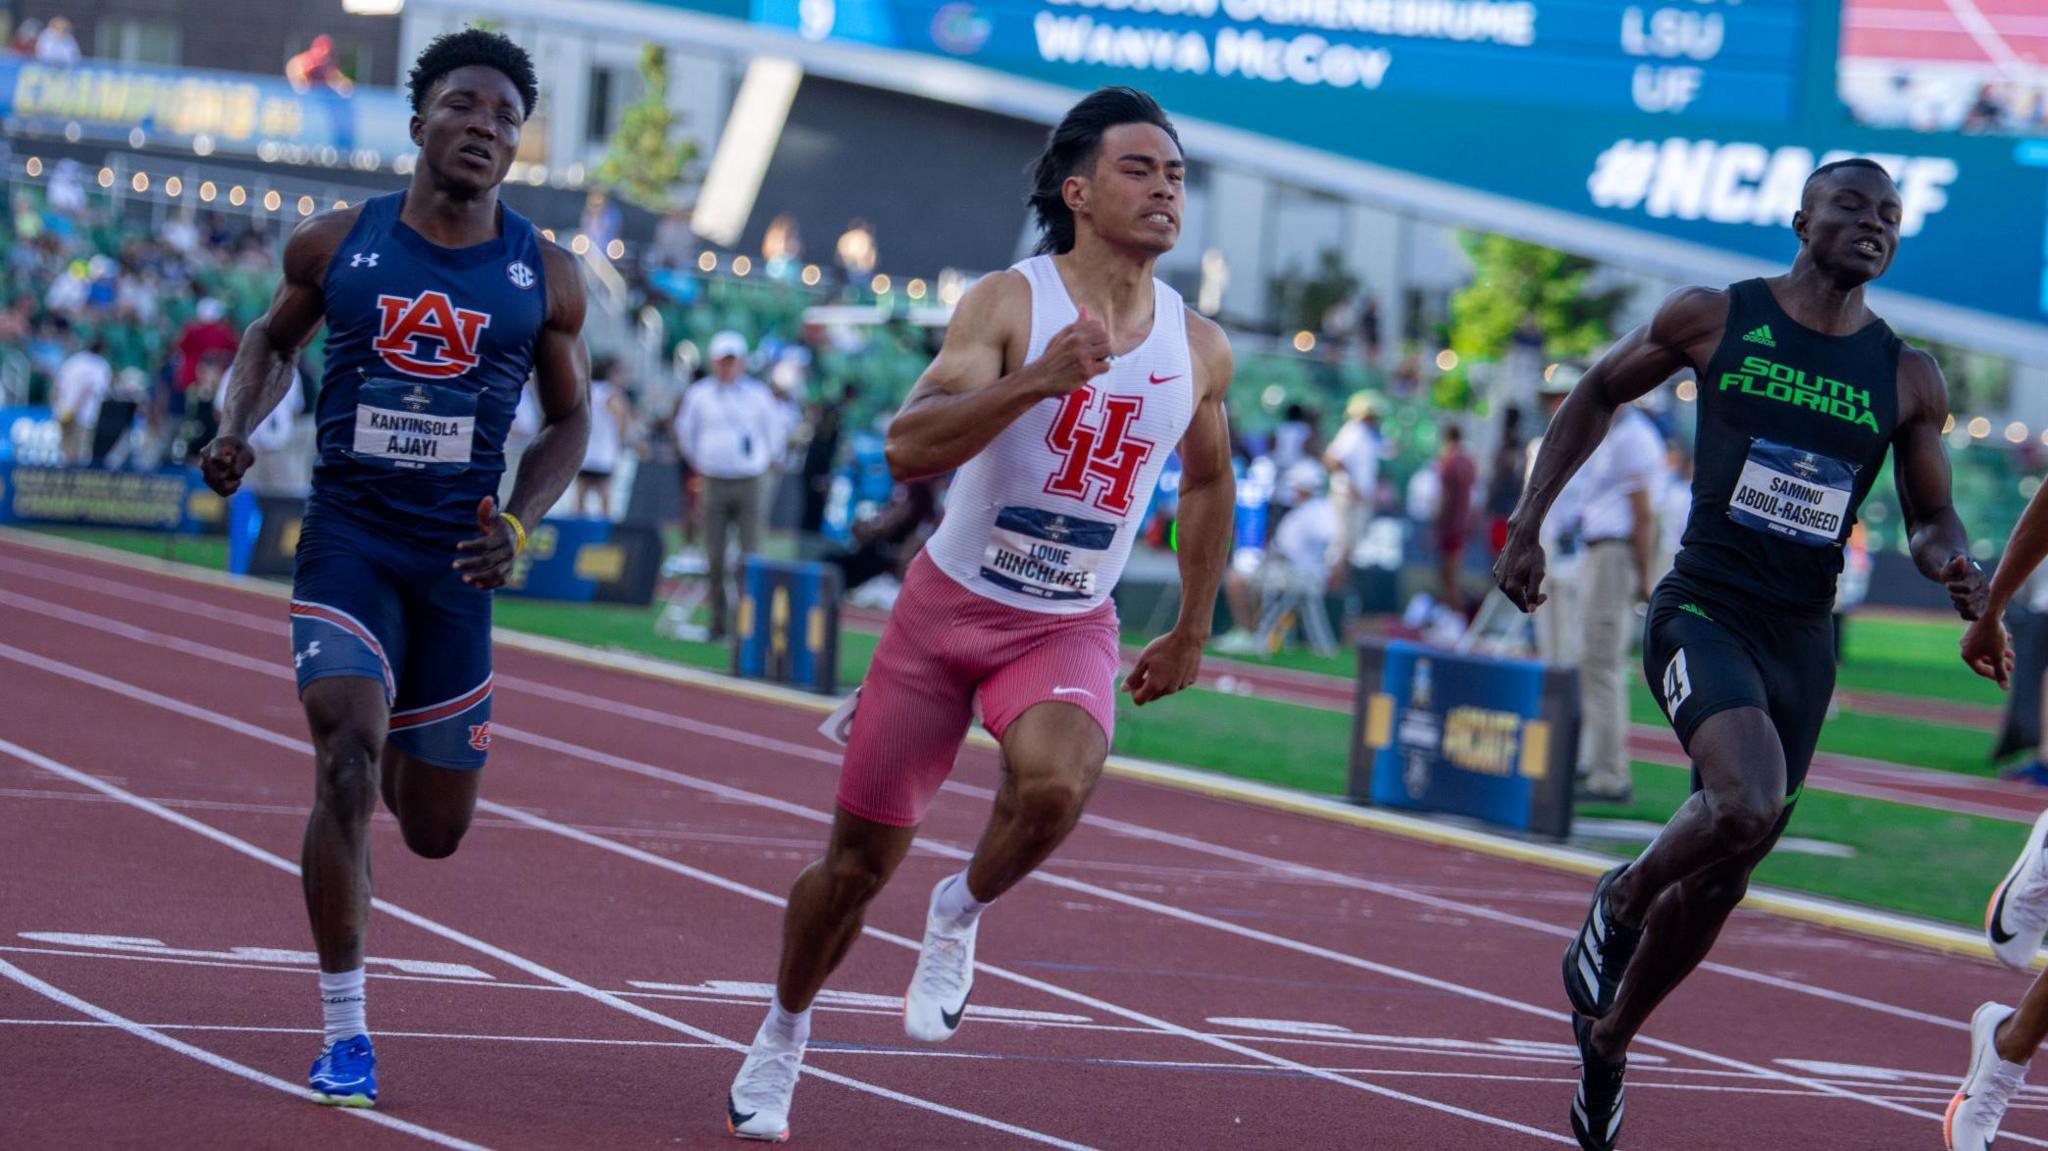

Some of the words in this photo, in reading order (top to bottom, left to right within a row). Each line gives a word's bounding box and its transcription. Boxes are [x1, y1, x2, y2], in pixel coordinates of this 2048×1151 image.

[1621, 6, 1724, 61] LSU
[1632, 63, 1704, 114] UF
[508, 262, 535, 288] SEC
[1742, 334, 1777, 348] adidas
[1740, 356, 1870, 408] SOUTH
[1719, 372, 1879, 434] FLORIDA
[370, 412, 459, 436] KANYINSOLA
[387, 435, 438, 457] AJAYI
[1735, 485, 1840, 533] ABDUL-RASHEED
[1770, 476, 1824, 505] SAMINU
[993, 549, 1088, 590] HINCHLIFFE
[1029, 543, 1071, 565] LOUIE
[1667, 659, 1684, 707] 4
